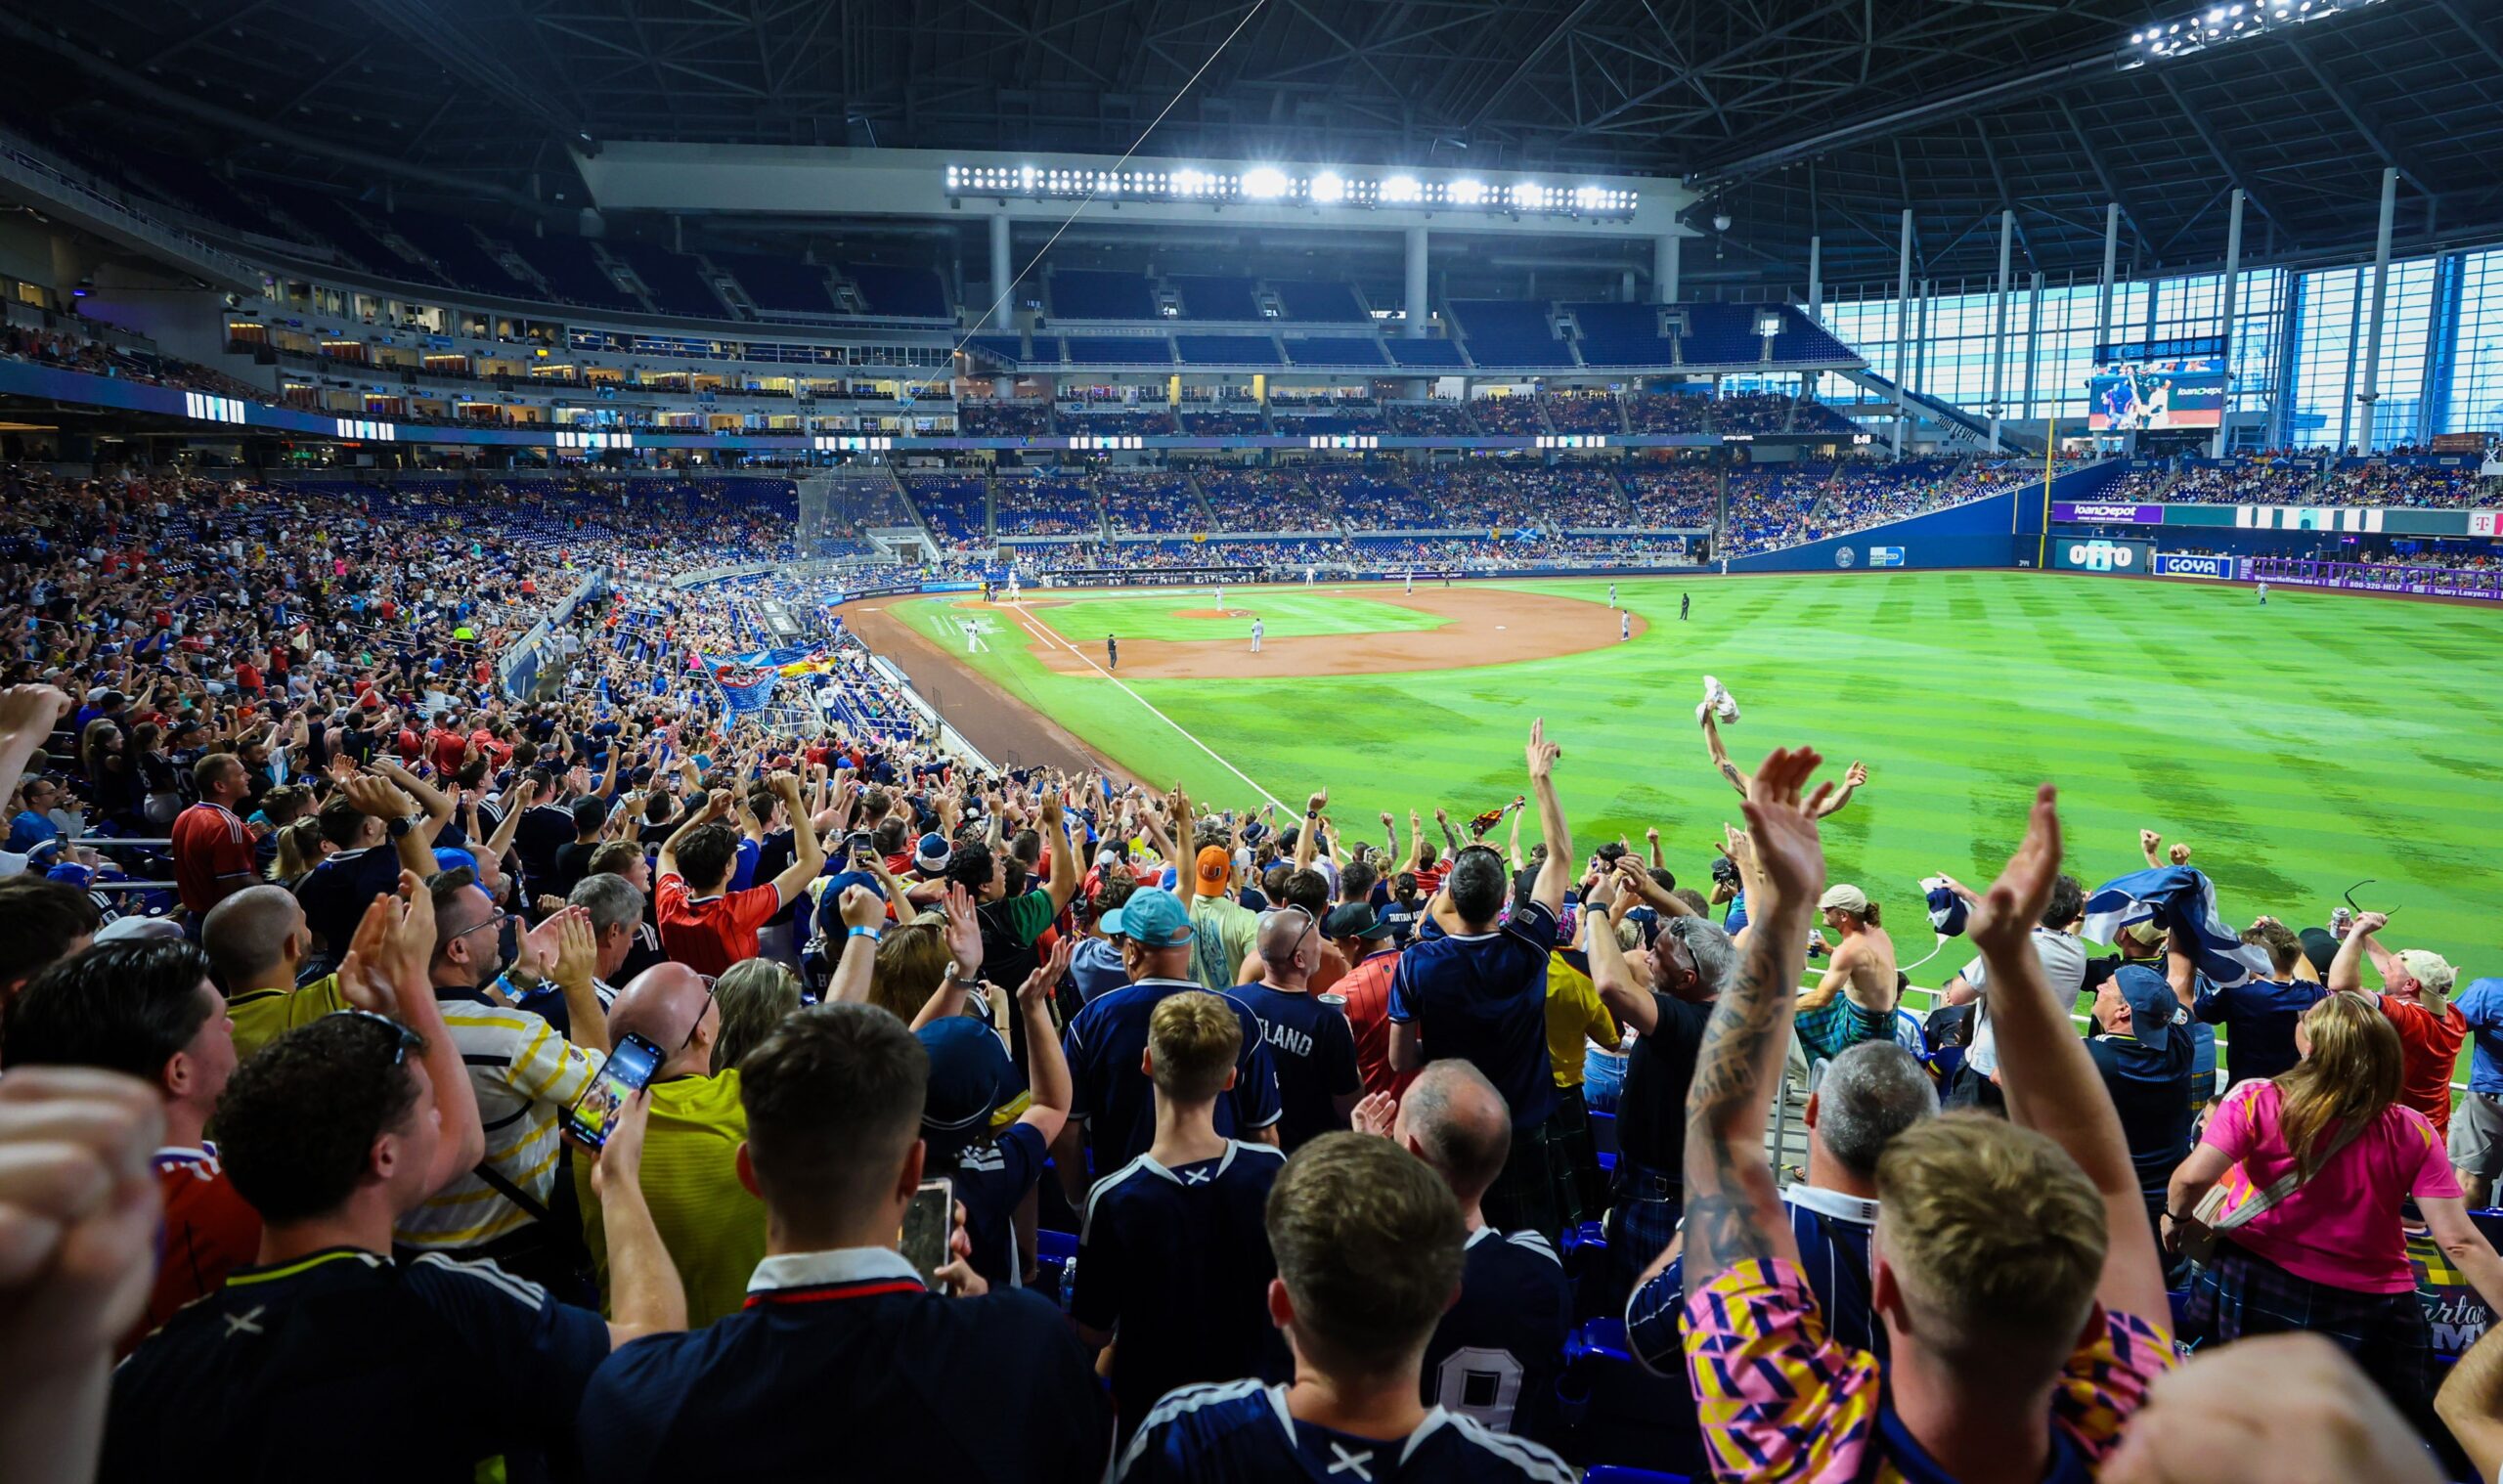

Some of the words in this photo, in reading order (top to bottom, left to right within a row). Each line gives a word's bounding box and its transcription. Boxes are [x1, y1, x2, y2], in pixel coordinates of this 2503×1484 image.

[1935, 414, 1955, 431] 300
[1953, 423, 1979, 445] LEVEL
[2074, 504, 2137, 517] loanDepot
[2169, 558, 2217, 574] GOYA
[2435, 588, 2457, 596] Injury
[2458, 589, 2490, 598] Lawyers
[1202, 863, 1221, 878] U
[1388, 912, 1412, 923] TARTAN
